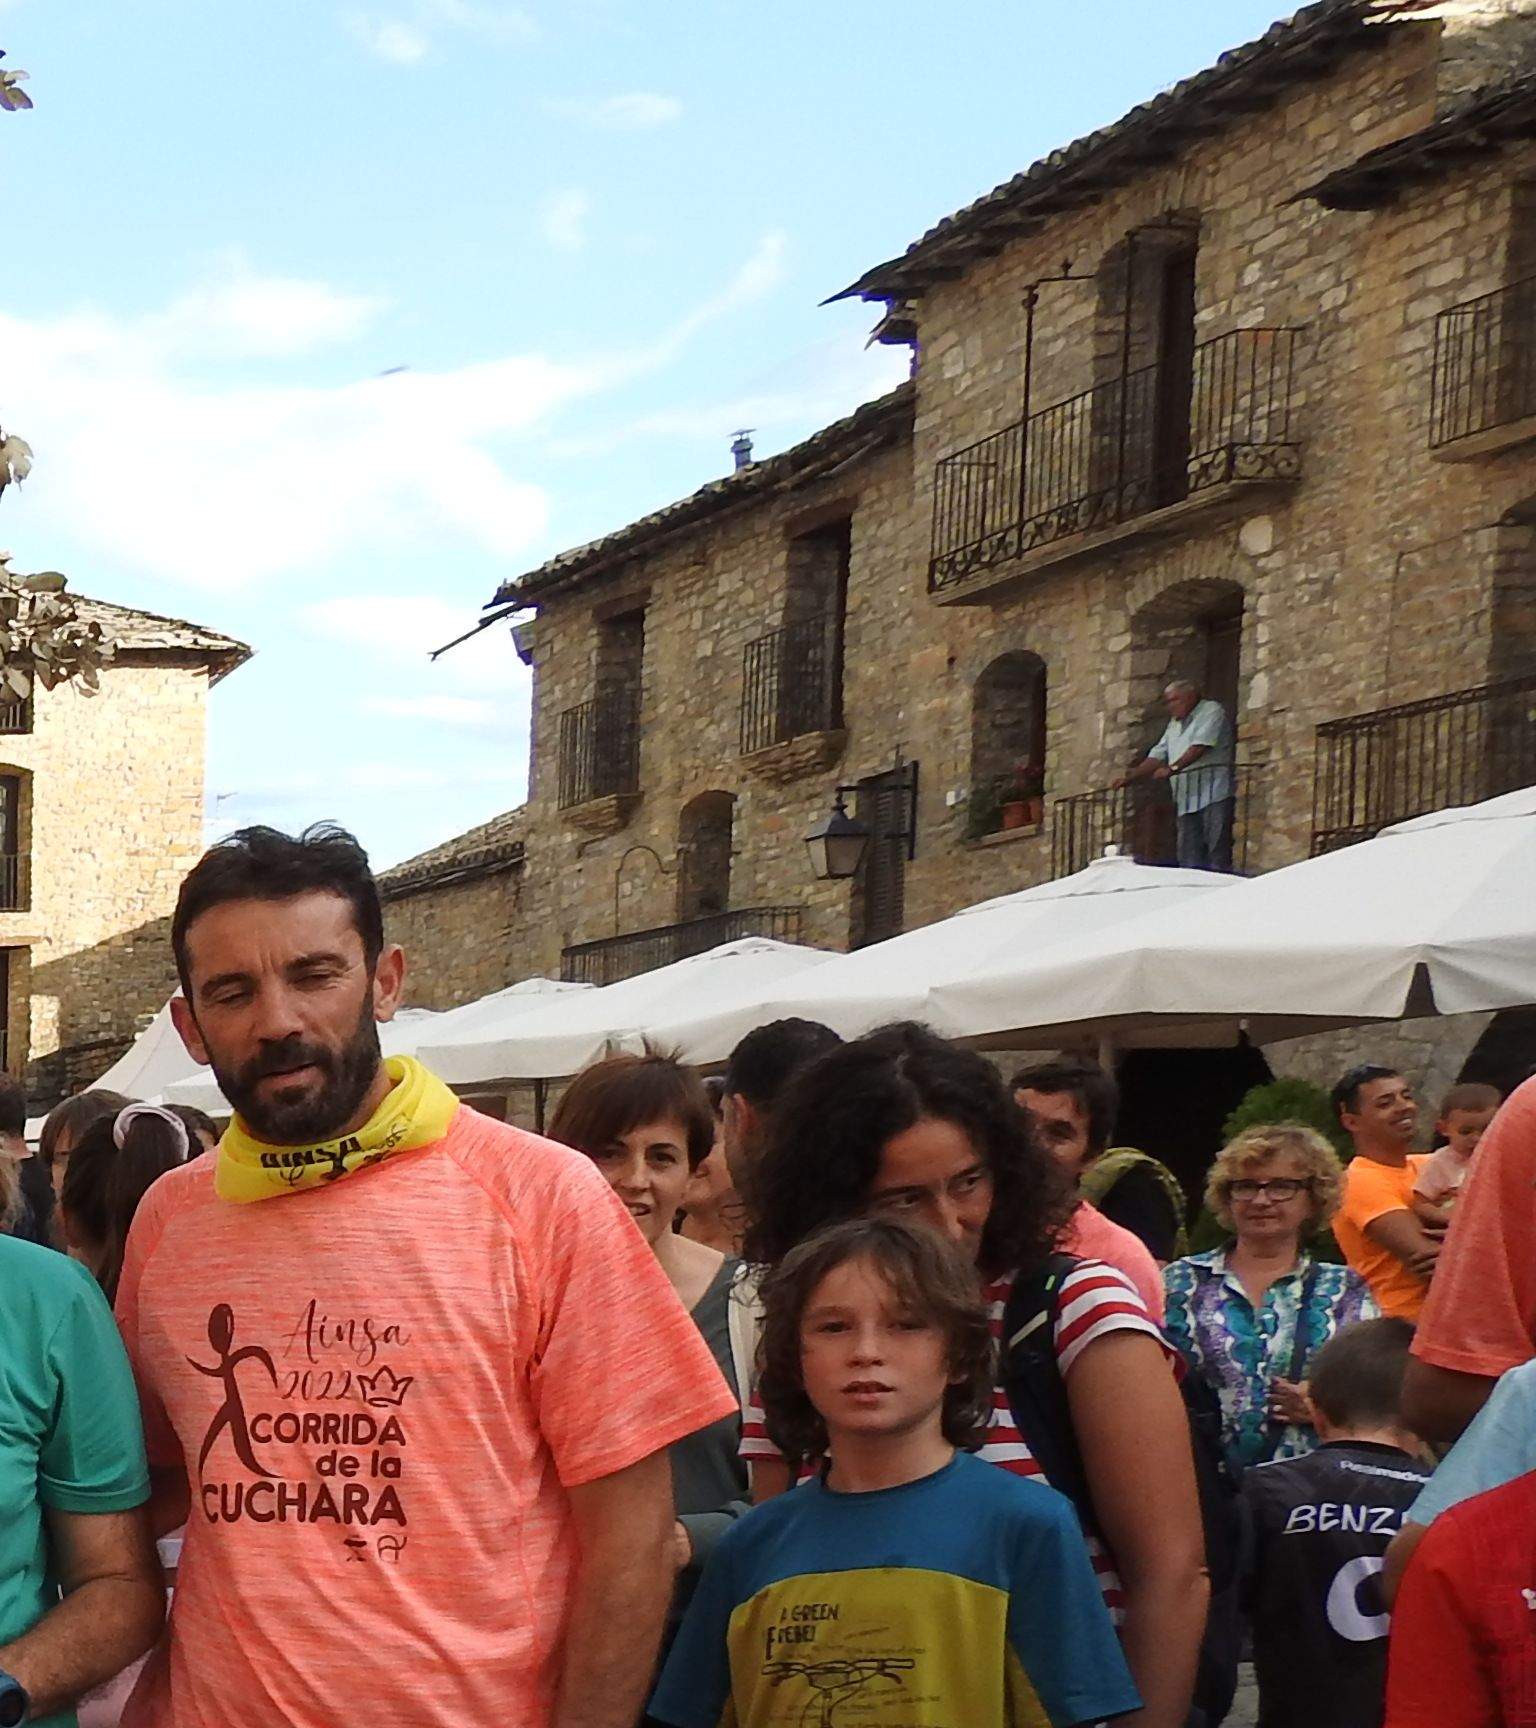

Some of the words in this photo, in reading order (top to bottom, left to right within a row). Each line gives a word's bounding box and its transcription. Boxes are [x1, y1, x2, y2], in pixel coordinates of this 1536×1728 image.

[281, 1370, 352, 1402] 2022
[250, 1412, 407, 1446] CORRIDA
[315, 1452, 361, 1478] de
[369, 1454, 402, 1479] la
[202, 1482, 408, 1526] CUCHARA
[1283, 1503, 1410, 1535] BENZ
